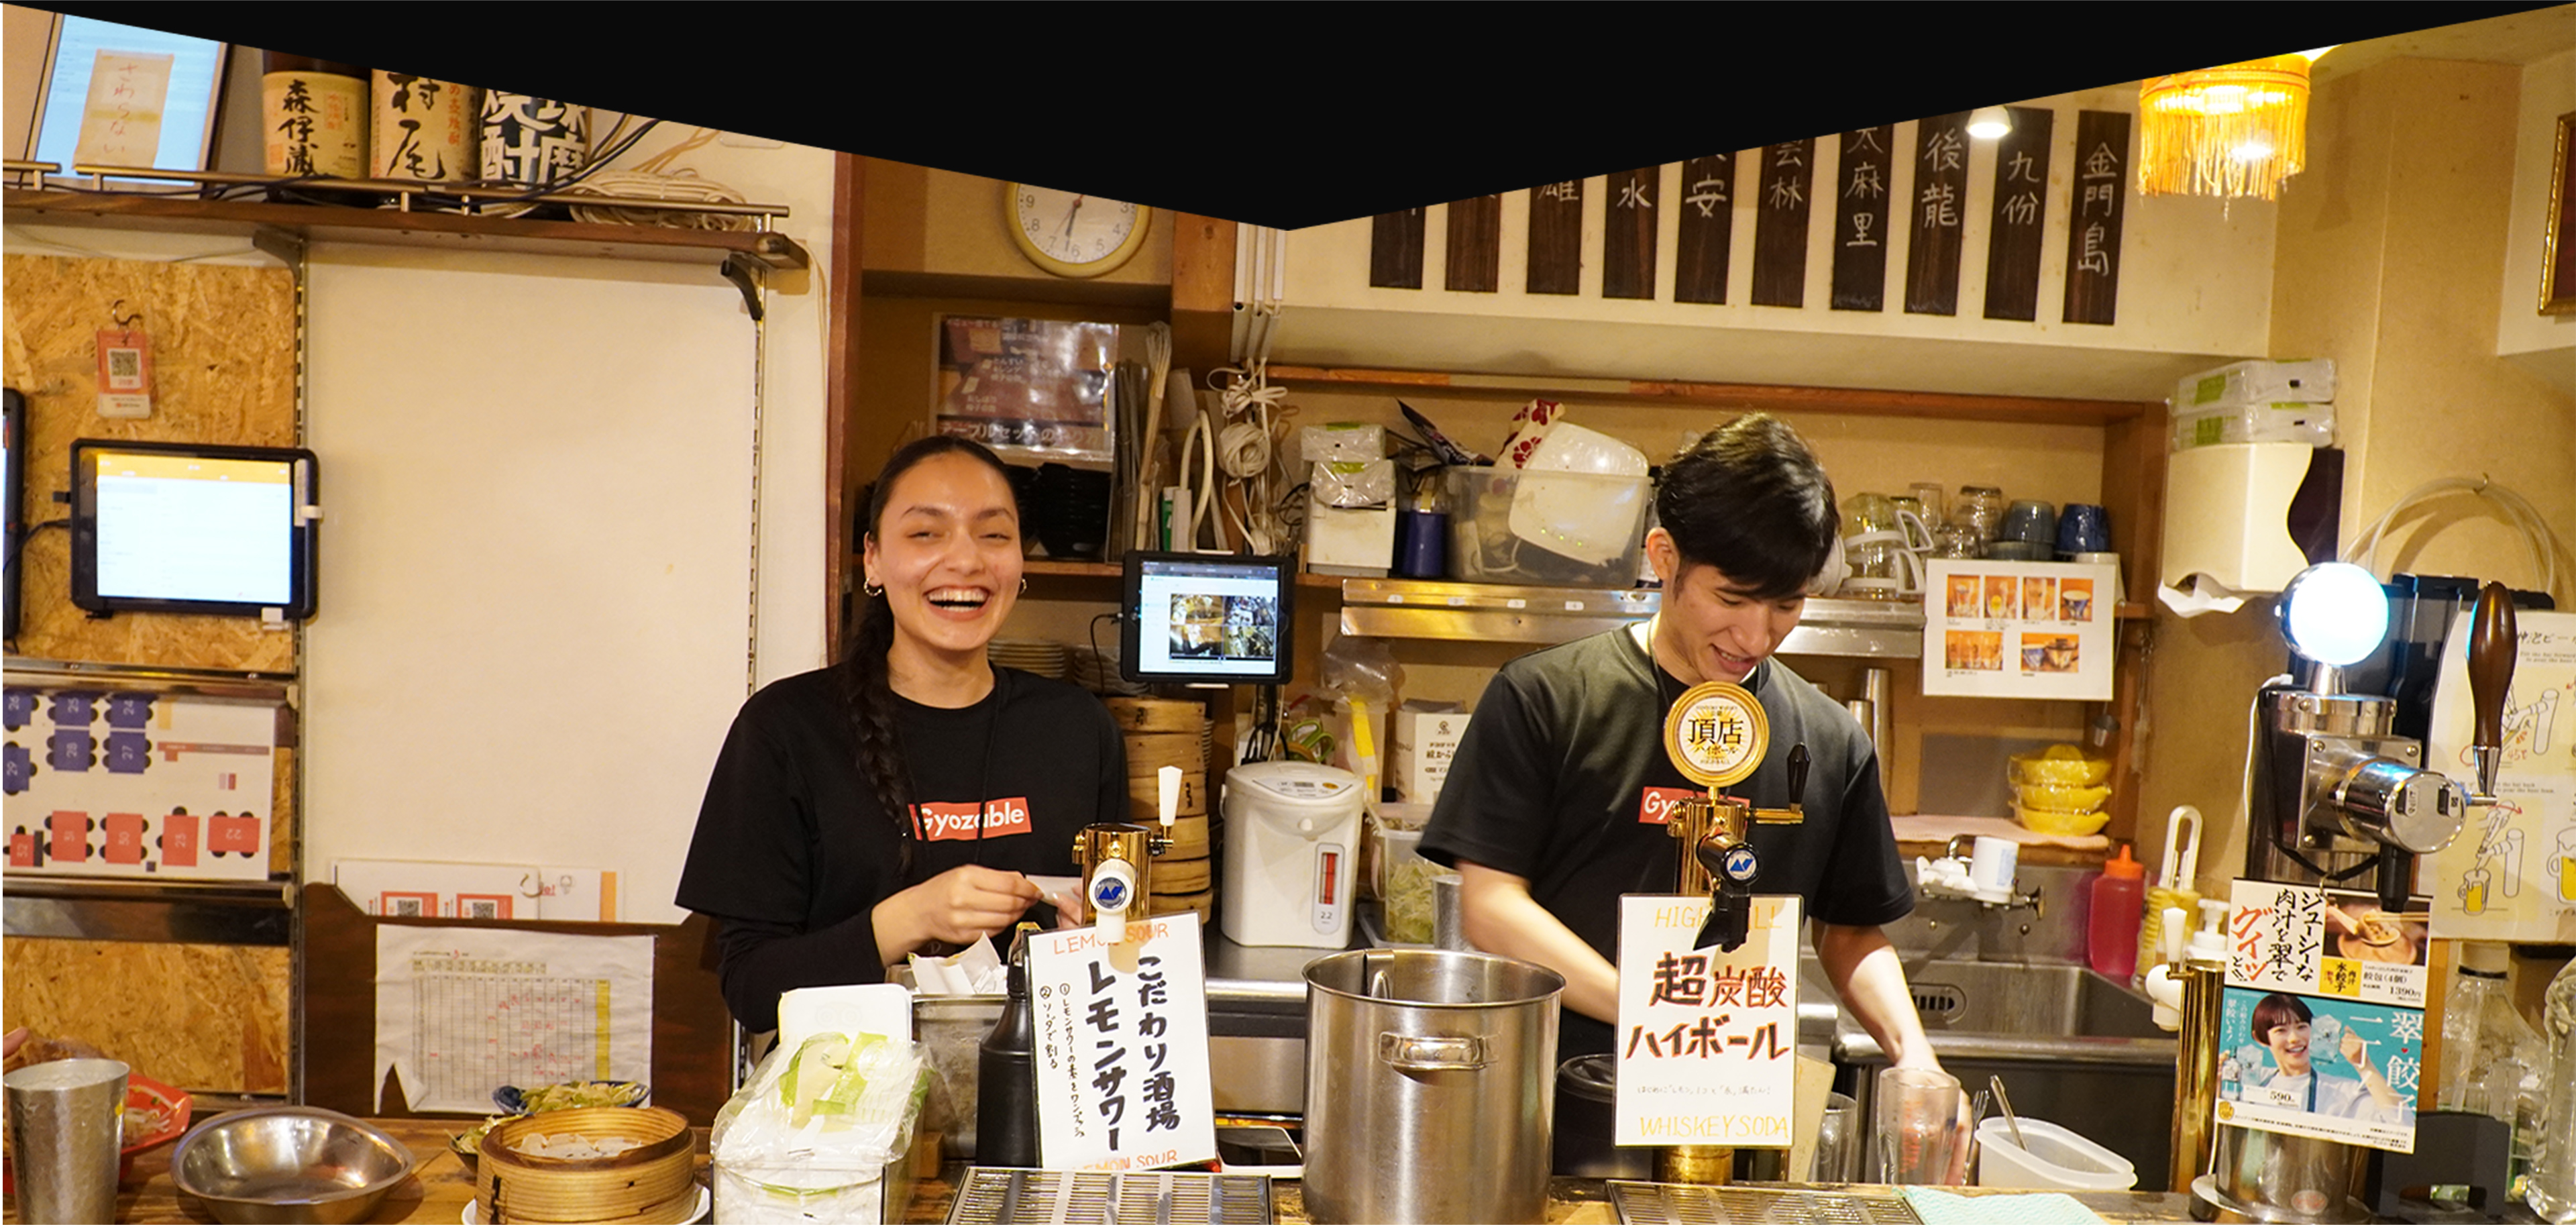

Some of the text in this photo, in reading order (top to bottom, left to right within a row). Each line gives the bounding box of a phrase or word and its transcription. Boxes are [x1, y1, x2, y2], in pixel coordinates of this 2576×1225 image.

[103, 62, 138, 154] さわらない
[387, 72, 445, 180] 村尾
[1617, 176, 1653, 209] 水
[1921, 127, 1963, 229] 後龍
[2002, 150, 2039, 225] 九份
[1026, 194, 1035, 209] 9
[2078, 142, 2118, 277] 金門島
[1031, 218, 1040, 232] 8
[1113, 223, 1121, 235] 4
[1049, 235, 1057, 248] 7
[1071, 244, 1081, 258] 6
[1095, 238, 1106, 252] 5
[123, 699, 134, 715] 24
[1687, 718, 1744, 745] 頂店
[121, 745, 133, 760] 27
[918, 802, 1025, 837] Gyozable
[1125, 922, 1169, 944] SOUR
[2296, 890, 2323, 982] ジューシーな
[1648, 951, 1788, 1008] 超炭酸
[1137, 955, 1181, 1133] こだわり酒場
[1625, 1014, 1790, 1061] ハイボール
[1085, 960, 1128, 1152] レモンサワー
[1640, 1114, 1789, 1139] WHISKEY SODA
[1136, 1149, 1178, 1168] SOUR
